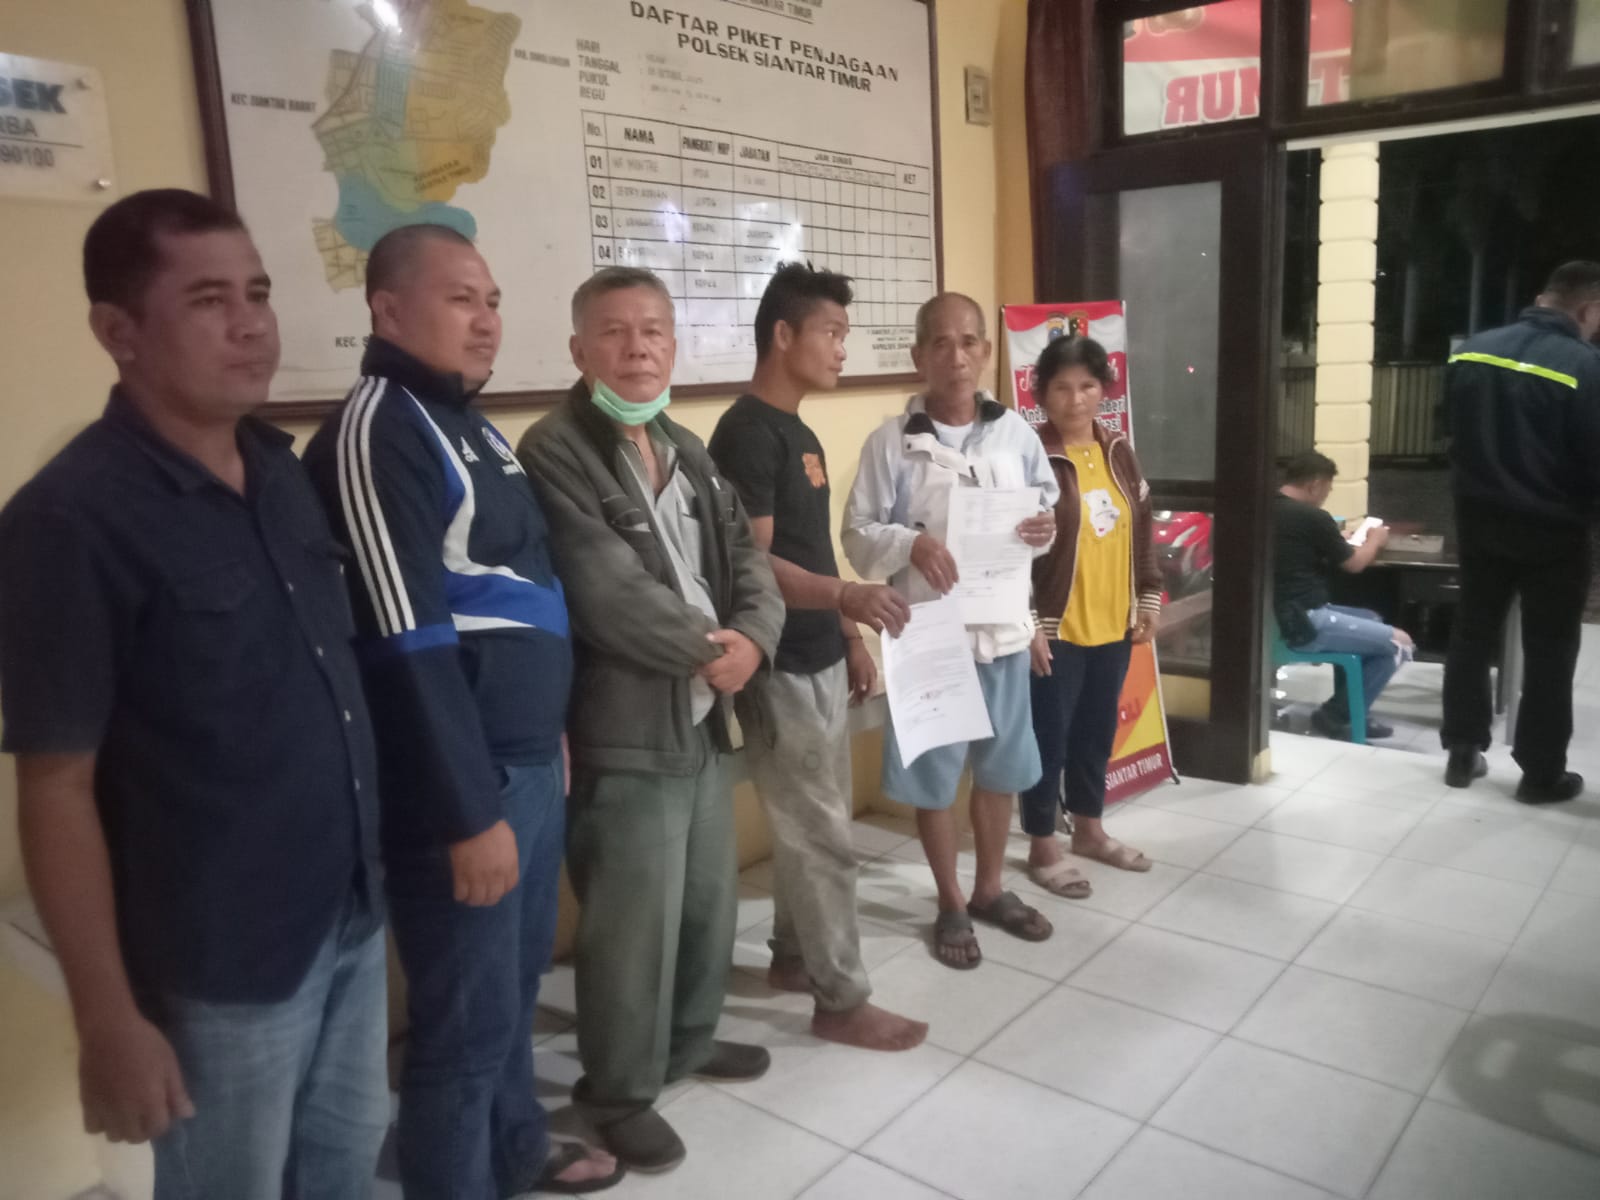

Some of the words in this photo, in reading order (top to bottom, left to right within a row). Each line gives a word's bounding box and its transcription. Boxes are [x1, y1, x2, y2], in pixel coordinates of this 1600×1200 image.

[630, 1, 719, 37] DAFTAR
[727, 25, 783, 50] PIKET
[790, 40, 899, 82] PENJAGAAN
[578, 54, 621, 74] TANGGAL
[677, 33, 749, 63] POLSEK
[753, 51, 825, 81] SIANTAR
[829, 69, 872, 92] TIMUR
[624, 127, 655, 145] NAMA
[590, 155, 603, 169] 01
[592, 185, 606, 200] 02
[595, 214, 608, 229] 03
[598, 245, 611, 260] 04
